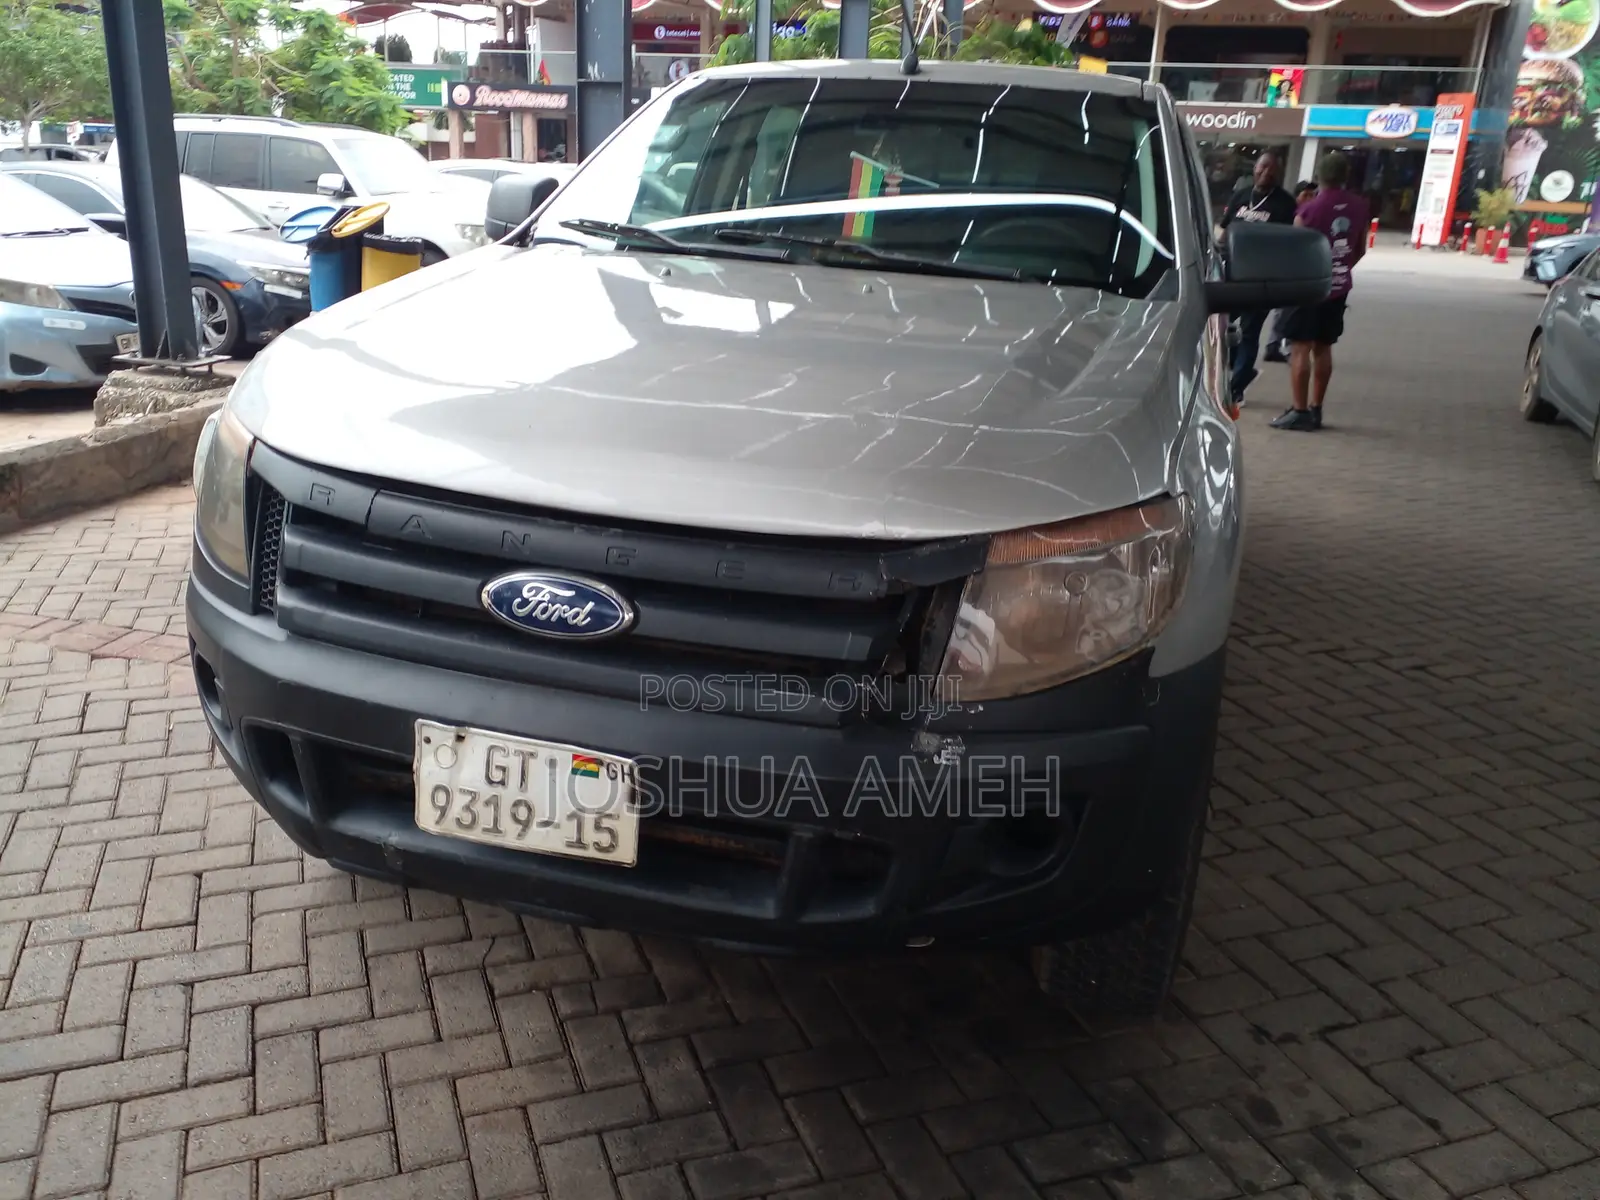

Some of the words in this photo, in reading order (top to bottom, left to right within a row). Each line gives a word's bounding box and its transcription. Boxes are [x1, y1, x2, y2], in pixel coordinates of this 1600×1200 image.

[1185, 111, 1257, 129] woodin
[309, 482, 865, 591] RANGER
[514, 582, 596, 628] Ford
[484, 744, 538, 792] GT
